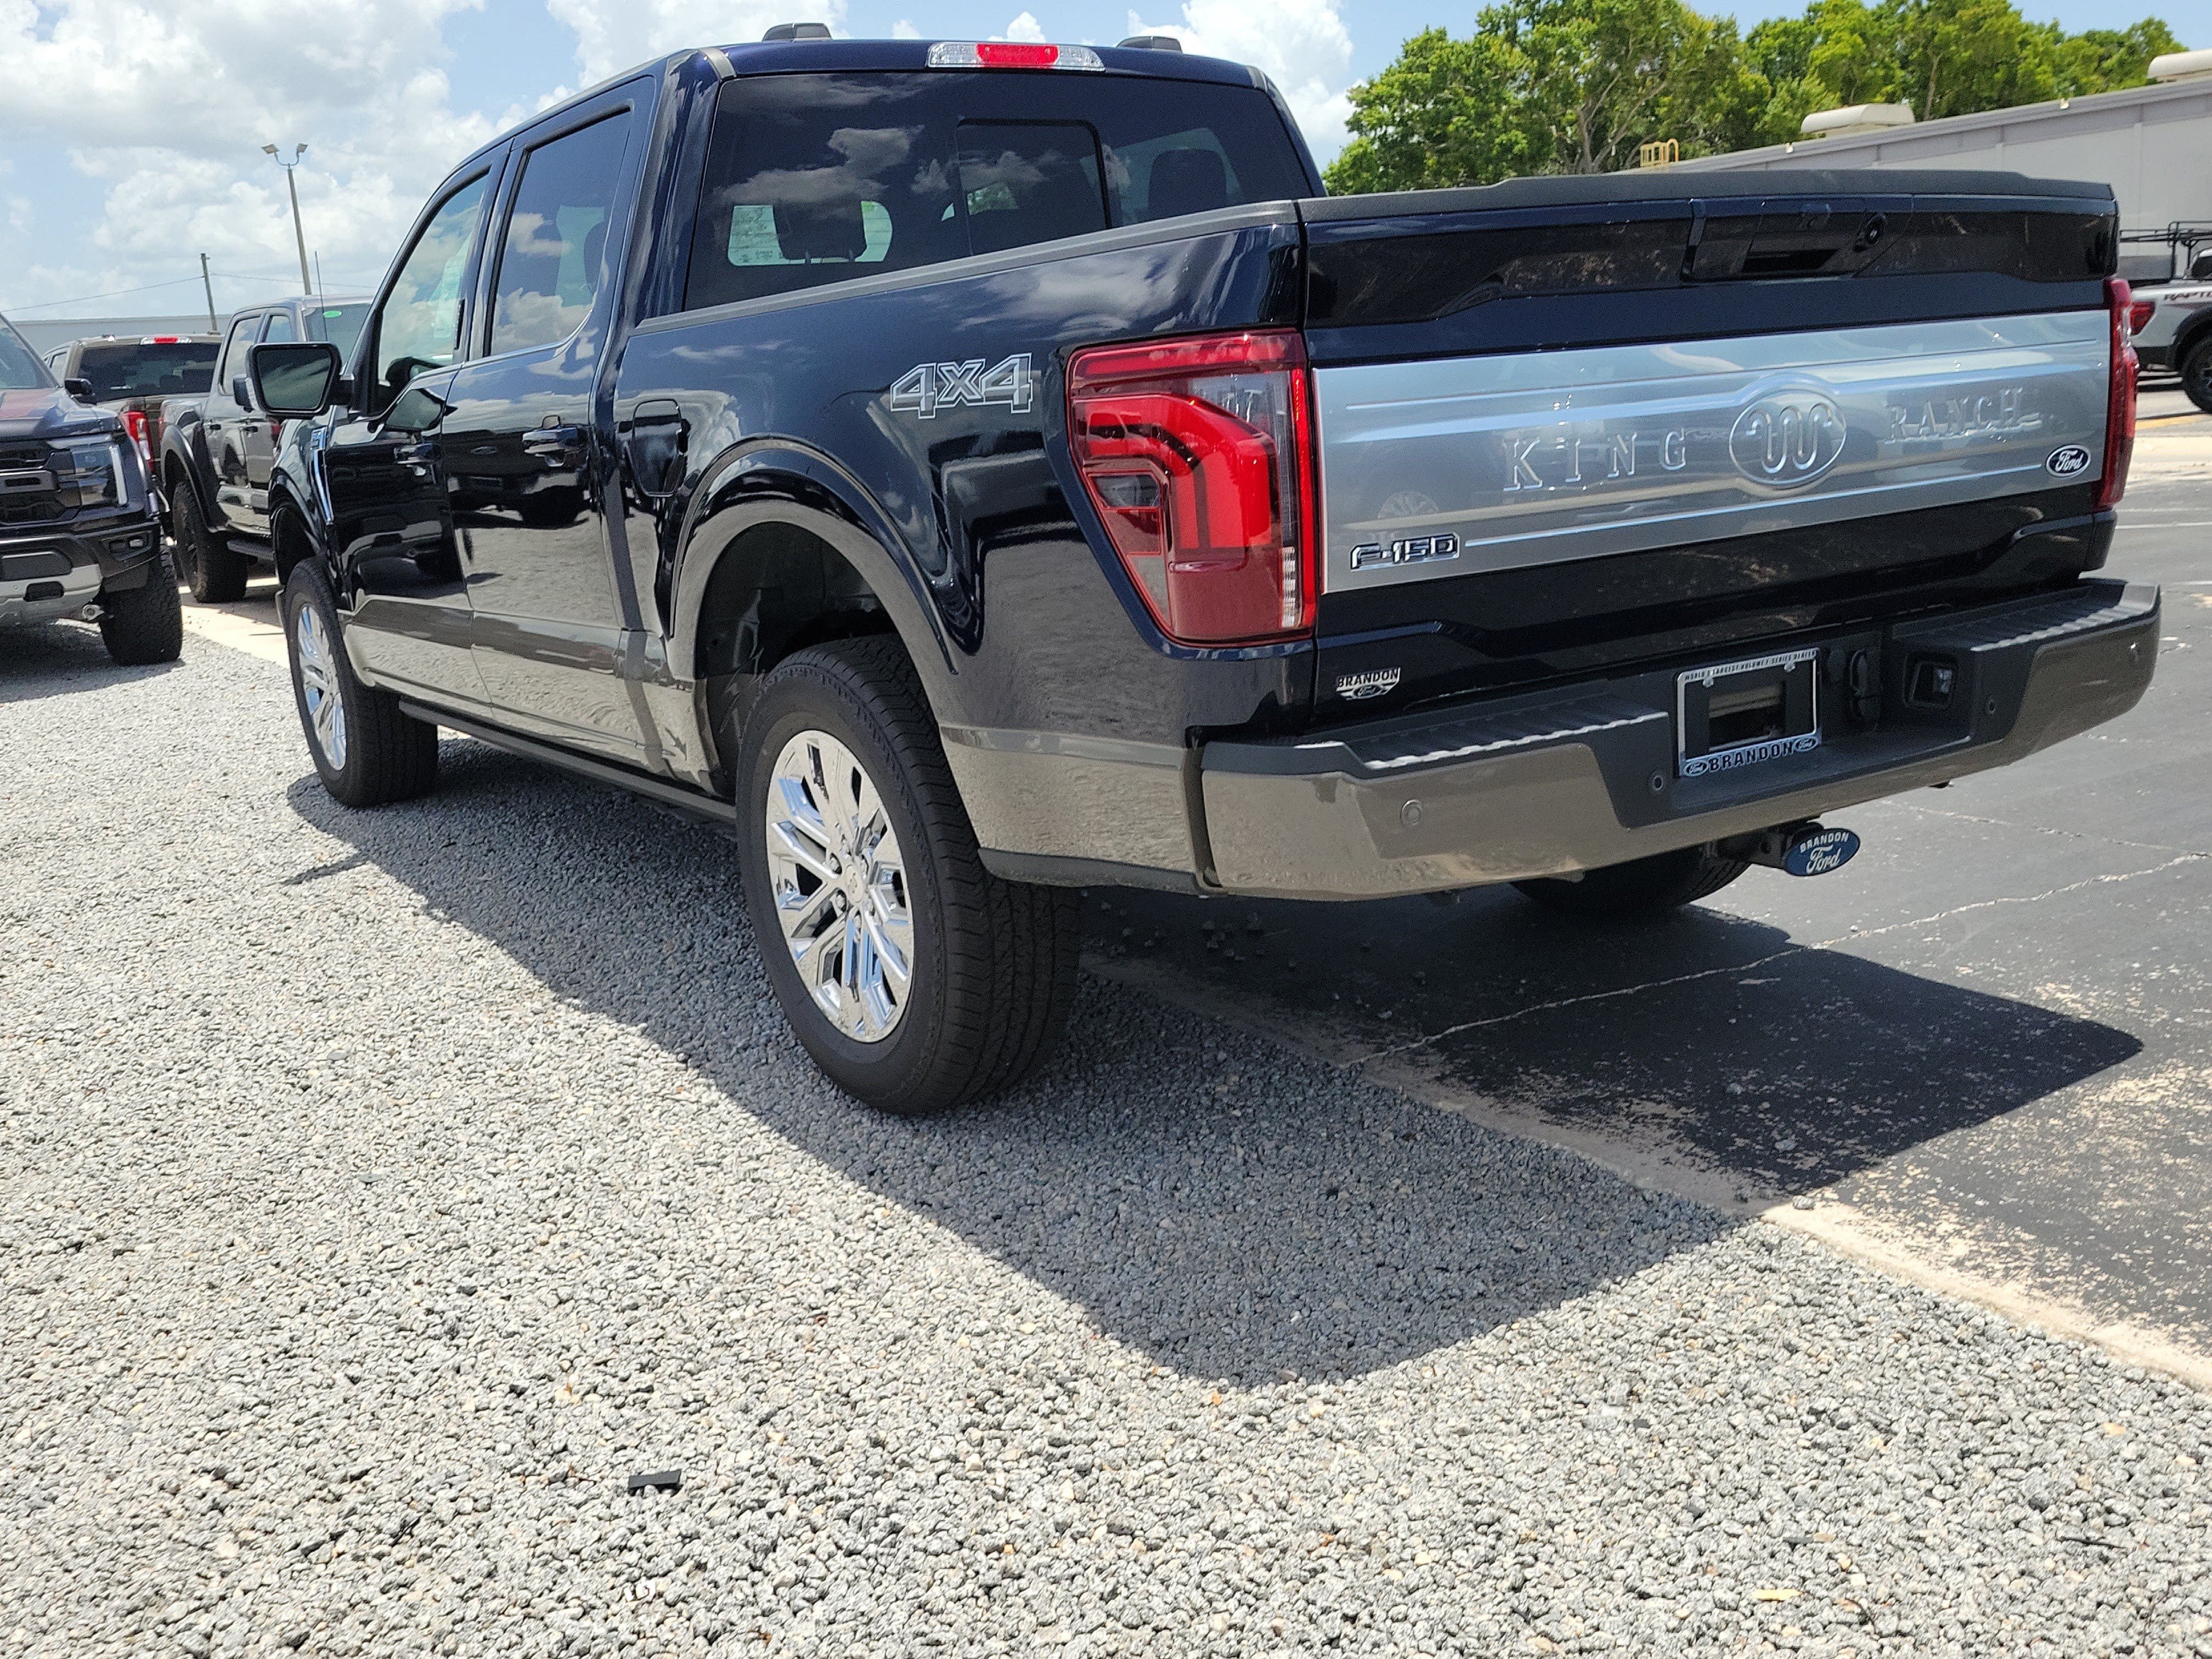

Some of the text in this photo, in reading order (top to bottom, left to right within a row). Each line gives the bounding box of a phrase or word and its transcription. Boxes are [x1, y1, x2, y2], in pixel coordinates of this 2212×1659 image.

[1503, 388, 2026, 492] KING RANCH
[2055, 450, 2084, 472] Ford
[1350, 533, 1459, 571] F-150
[1338, 668, 1398, 687] BRANDON
[1708, 741, 1793, 771] BRANDON
[1799, 832, 1849, 853] BRANDON
[1805, 844, 1842, 874] Ford
